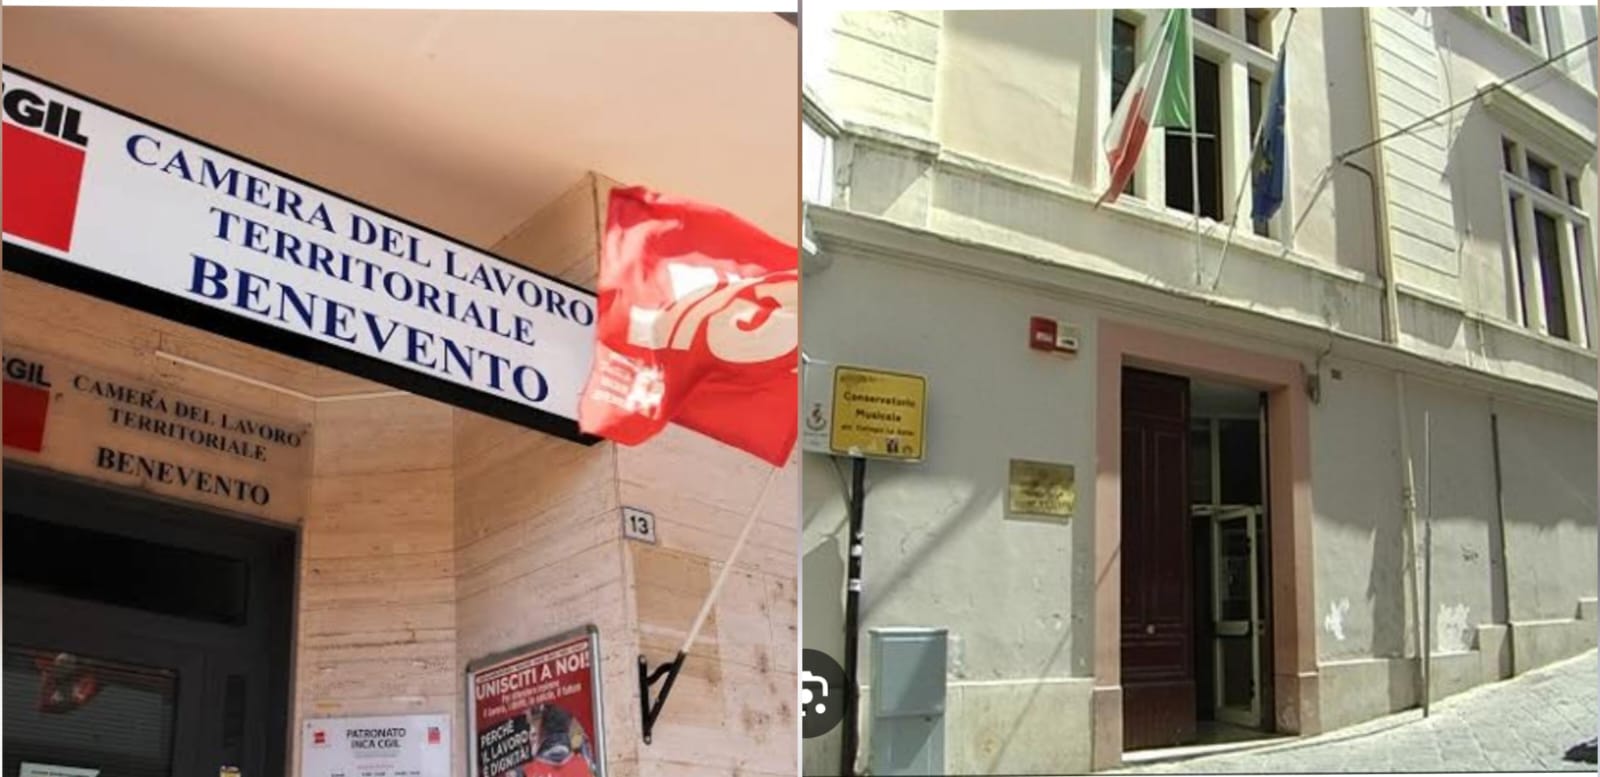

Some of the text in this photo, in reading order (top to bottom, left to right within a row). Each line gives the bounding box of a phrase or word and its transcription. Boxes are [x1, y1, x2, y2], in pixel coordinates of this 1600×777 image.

[2, 81, 88, 147] GIL
[125, 132, 595, 328] CAMERA DEL LAVORO
[208, 205, 537, 347] TERRITORIALE
[188, 254, 550, 404] BENEVENTO
[2, 356, 51, 388] GIL
[73, 375, 302, 448] CAMERA DEL LAVORO
[843, 391, 916, 408] Conservatorio
[855, 408, 902, 423] Musicale
[109, 407, 267, 462] TERRITORIALE
[96, 446, 270, 506] BENEVENTO
[630, 515, 649, 535] 13
[475, 667, 538, 701] UNISCITI
[541, 663, 552, 682] A
[555, 650, 591, 676] NOI!
[346, 728, 407, 739] PATRONATO
[351, 739, 402, 749] INCA CGIL
[491, 729, 529, 759] LAVORO
